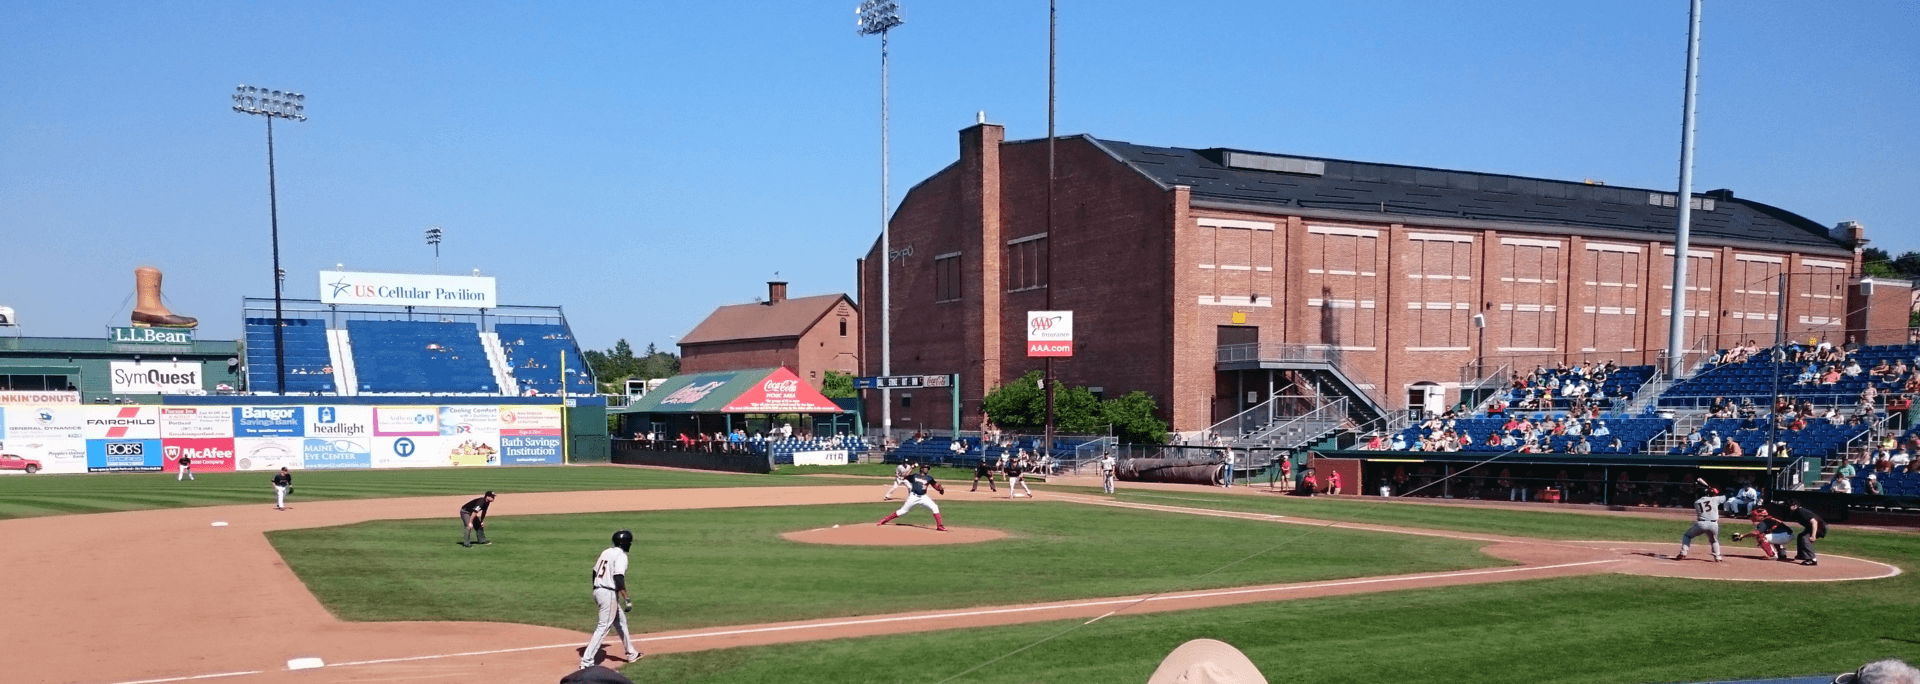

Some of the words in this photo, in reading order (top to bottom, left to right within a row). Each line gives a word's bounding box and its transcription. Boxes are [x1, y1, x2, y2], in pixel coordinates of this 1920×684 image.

[354, 284, 377, 298] U.S.
[378, 285, 432, 299] Cellular
[435, 287, 485, 301] Pavilion
[1033, 316, 1051, 330] AAA
[116, 328, 187, 343] L.L.Bean
[1030, 344, 1070, 352] AAA.com
[115, 368, 196, 388] SymQuest
[764, 379, 799, 392] Coca-Cola
[0, 394, 32, 403] NKIN'
[241, 406, 295, 420] Bangor
[240, 418, 274, 426] Savings
[275, 418, 299, 426] Bank
[313, 423, 364, 436] headlight
[304, 444, 334, 452] MAINE
[501, 437, 524, 447] Bath
[525, 437, 560, 449] Savings
[108, 444, 141, 455] BOB'S
[183, 447, 232, 459] McAfee
[506, 446, 556, 456] Institution
[304, 453, 320, 461] EYE
[321, 452, 357, 461] CENTER
[1697, 500, 1712, 513] 13
[595, 559, 608, 579] 15
